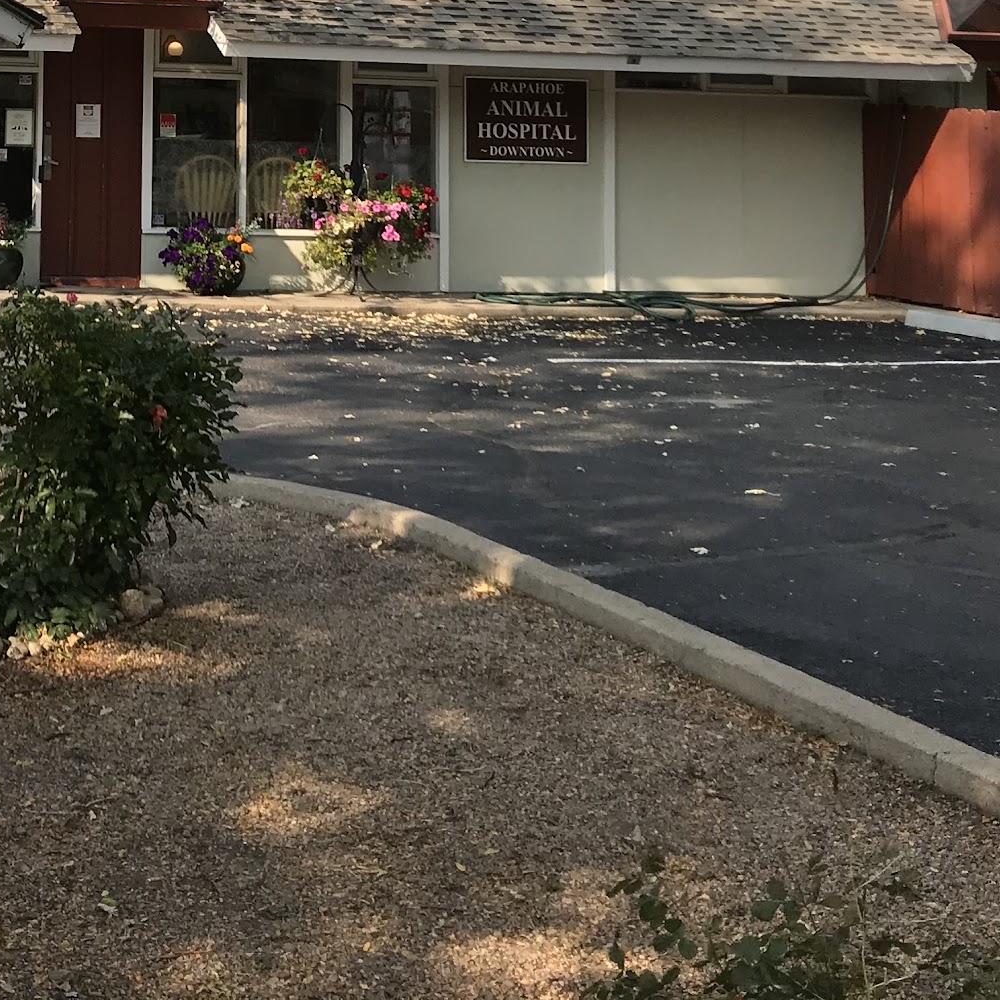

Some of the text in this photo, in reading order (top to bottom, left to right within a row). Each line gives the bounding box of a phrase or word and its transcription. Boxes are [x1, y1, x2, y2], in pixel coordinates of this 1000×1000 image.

[489, 81, 565, 95] ARAPAHOE
[486, 100, 568, 117] ANIMAL
[477, 122, 577, 140] HOSPITAL
